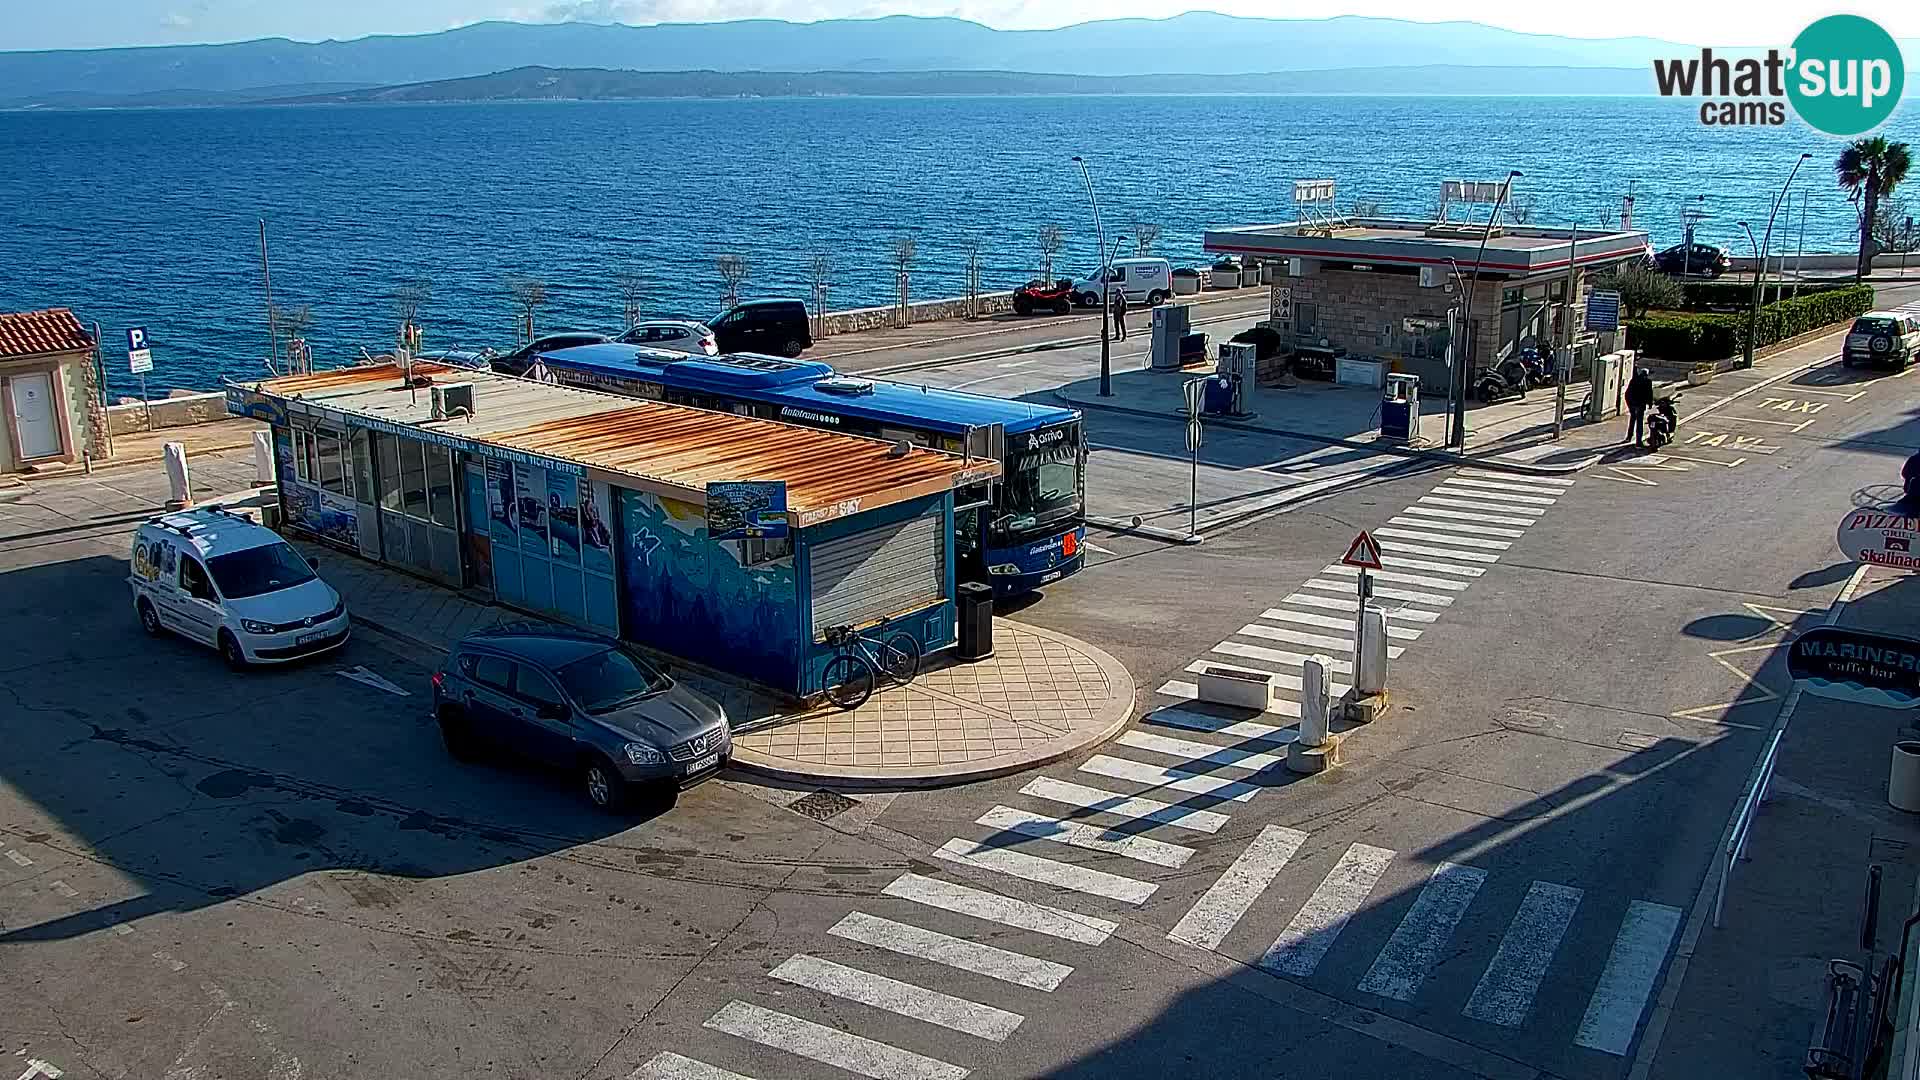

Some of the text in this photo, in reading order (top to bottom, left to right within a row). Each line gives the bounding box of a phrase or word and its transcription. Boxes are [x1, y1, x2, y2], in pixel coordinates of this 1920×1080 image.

[130, 329, 143, 348] P
[1757, 397, 1829, 414] TAXI
[397, 427, 437, 443] AUTOBUSNA
[437, 437, 468, 450] POSTAJA
[479, 445, 493, 456] BUS
[495, 449, 526, 464] STATION
[529, 455, 554, 470] TICKET
[557, 462, 582, 475] OFFICE
[1848, 514, 1920, 532] PIZZE
[1881, 529, 1917, 540] GRILL
[1870, 664, 1896, 679] bar
